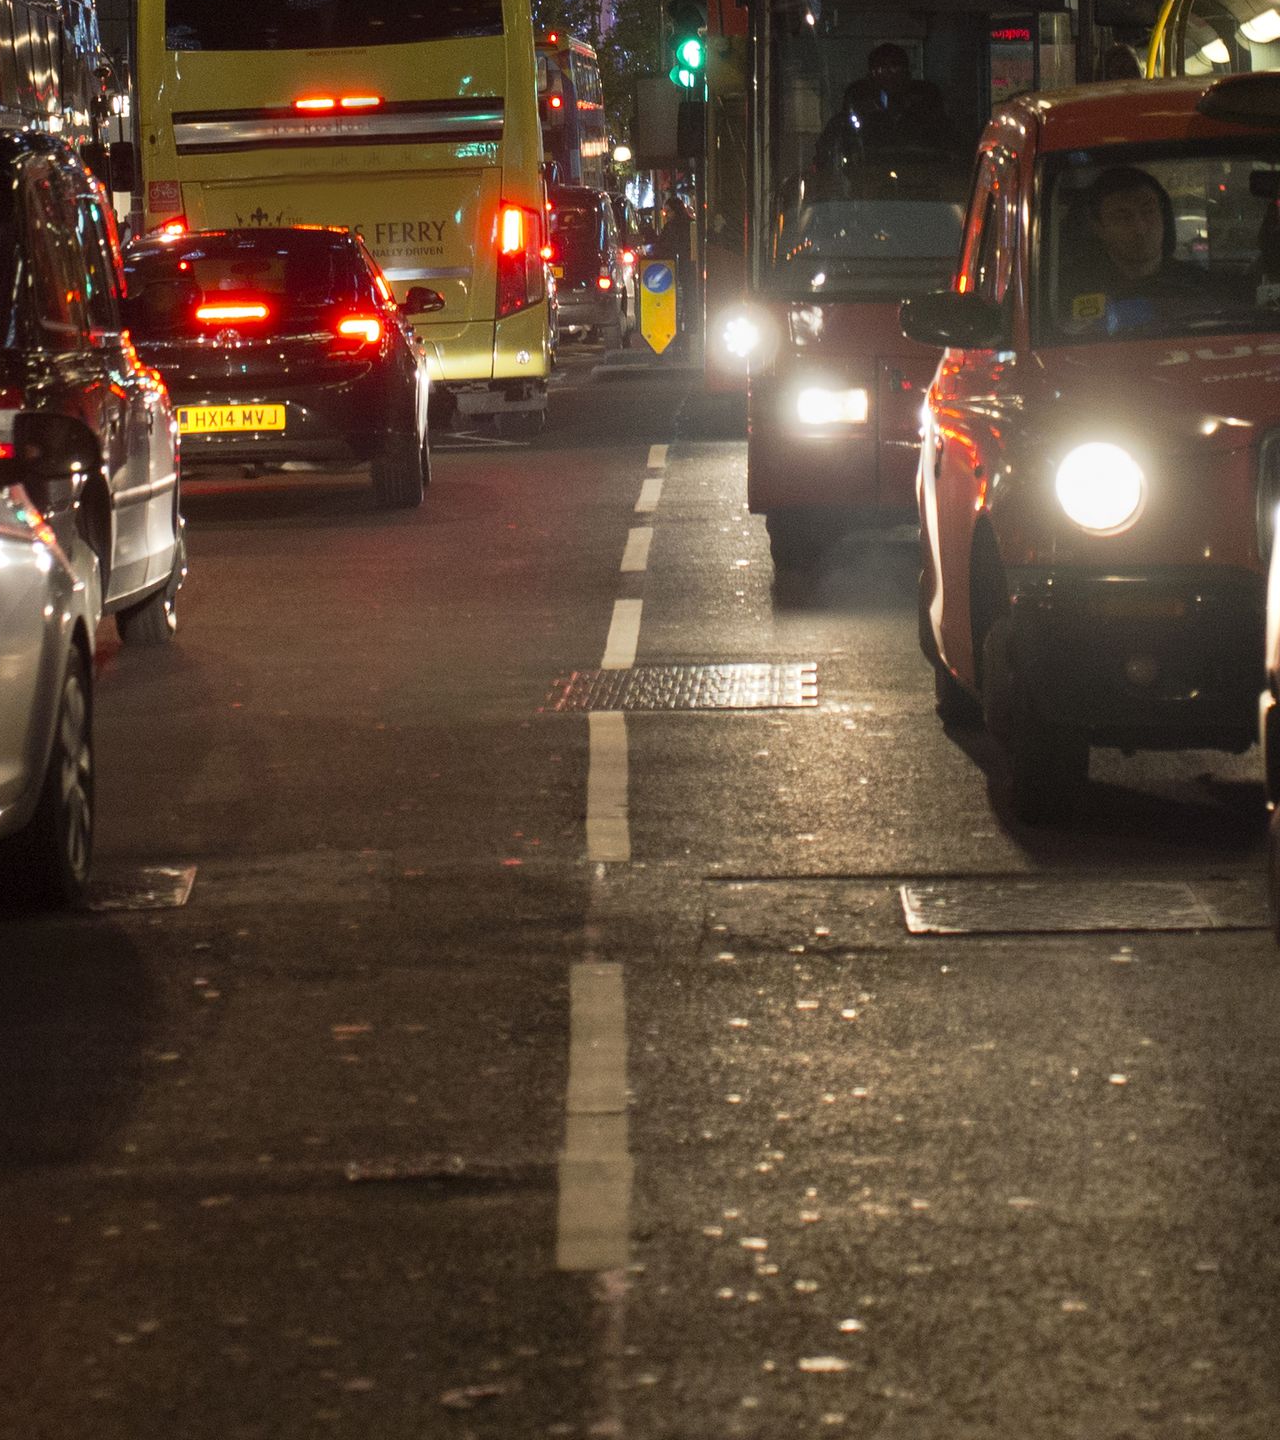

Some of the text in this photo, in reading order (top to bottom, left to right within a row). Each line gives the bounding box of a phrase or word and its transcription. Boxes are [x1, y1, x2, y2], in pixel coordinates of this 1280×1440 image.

[374, 220, 447, 245] FERRY
[195, 408, 278, 428] HX14 MVJ
